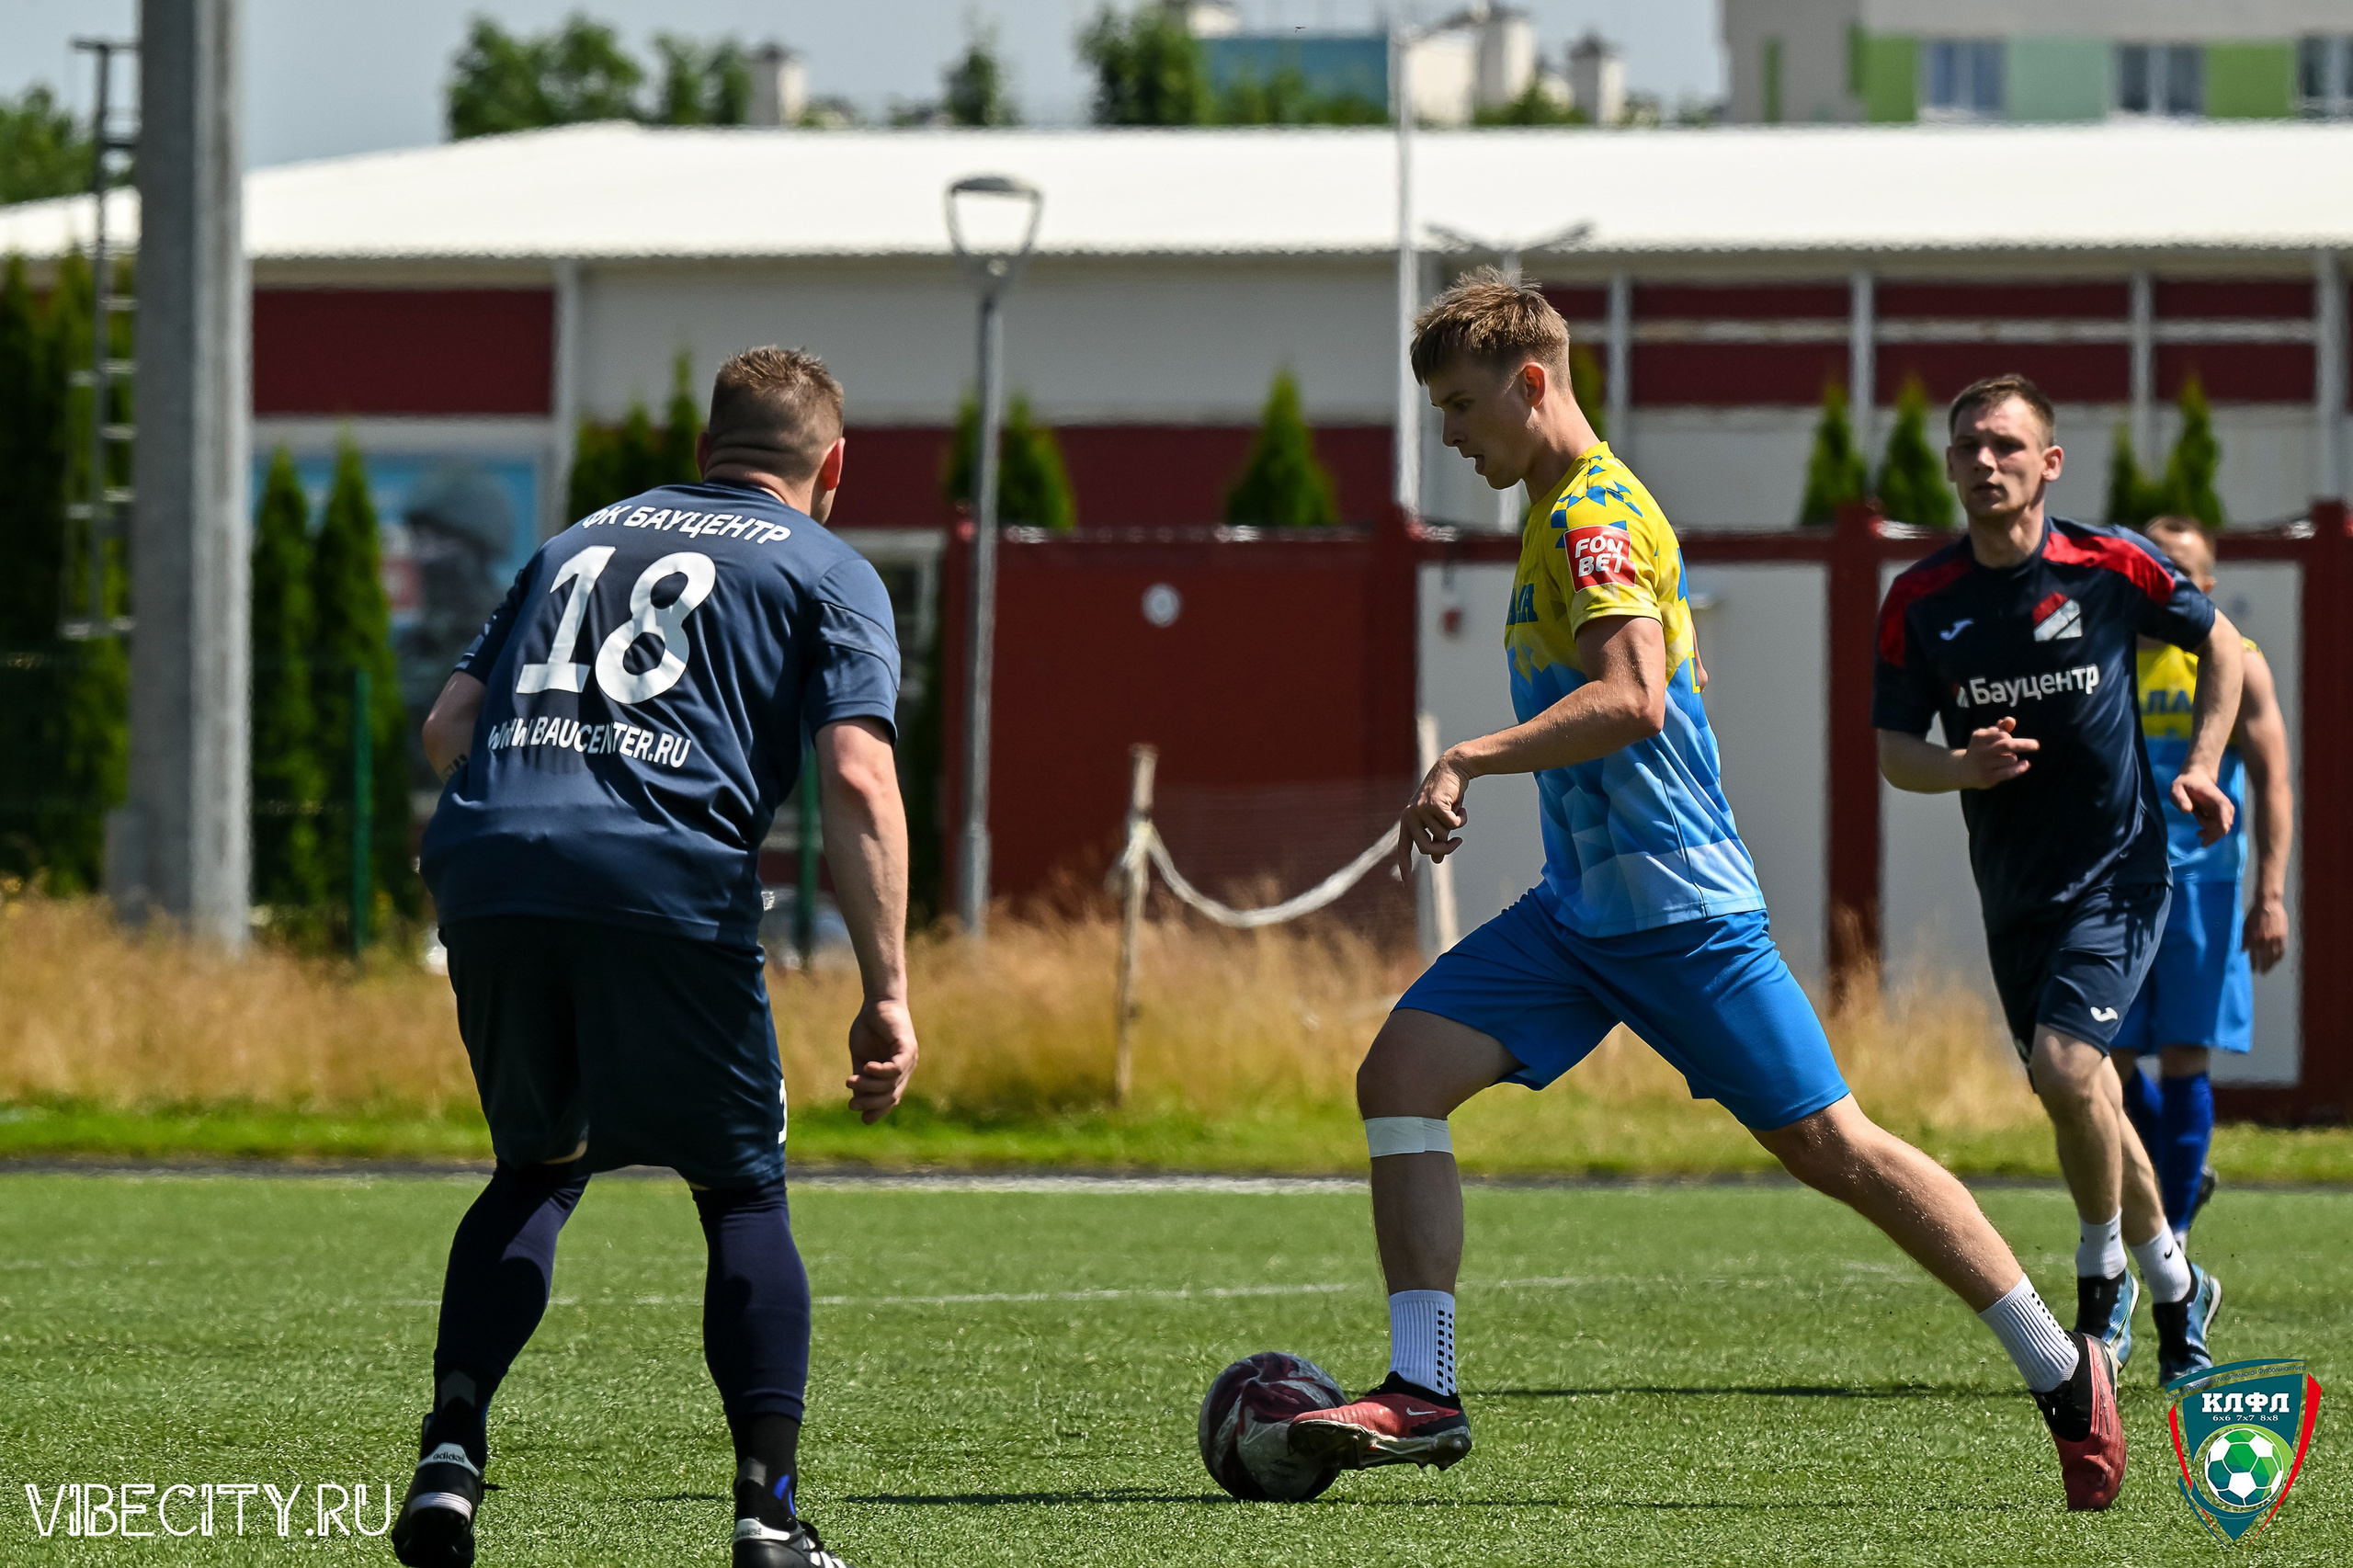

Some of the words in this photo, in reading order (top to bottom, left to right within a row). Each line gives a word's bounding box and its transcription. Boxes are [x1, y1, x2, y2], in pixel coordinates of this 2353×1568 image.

[582, 505, 632, 529] ФК
[626, 506, 791, 545] БАУЦЕНТР
[1574, 535, 1624, 559] FON
[1578, 552, 1625, 577] BET
[516, 545, 717, 706] 18
[1970, 663, 2100, 708] Бауцентр
